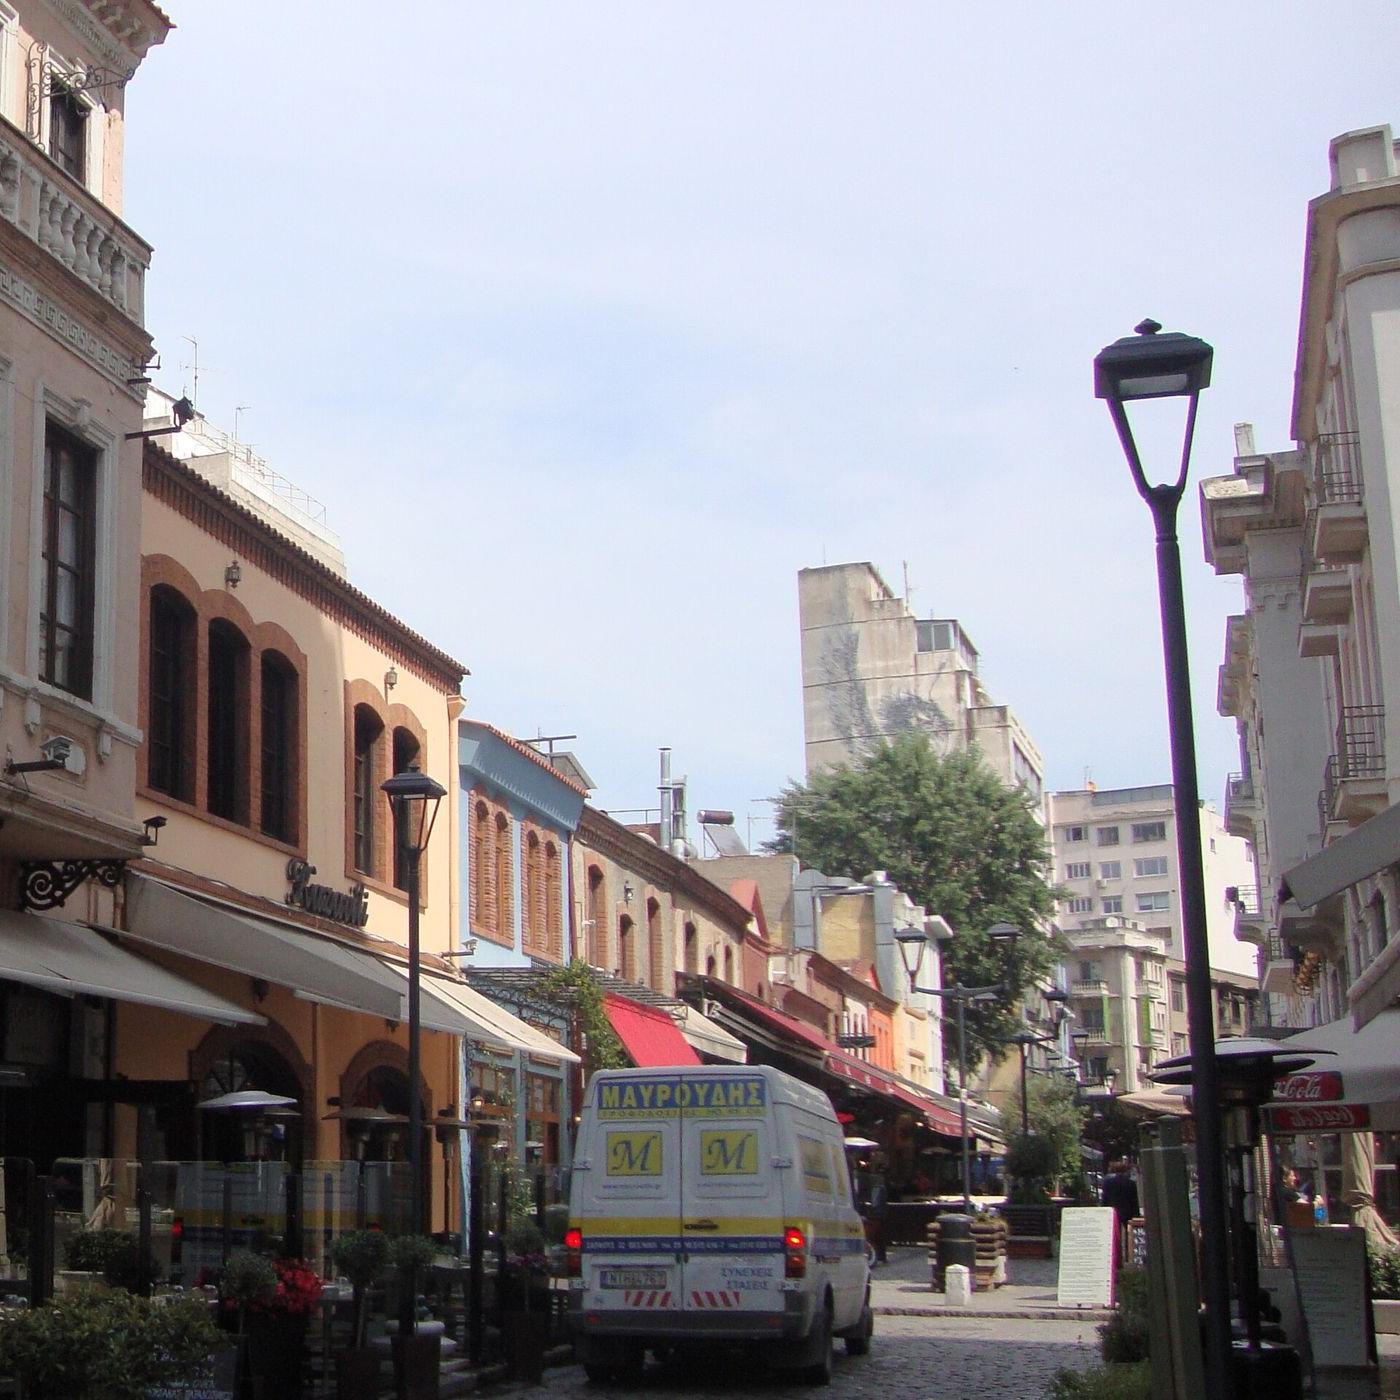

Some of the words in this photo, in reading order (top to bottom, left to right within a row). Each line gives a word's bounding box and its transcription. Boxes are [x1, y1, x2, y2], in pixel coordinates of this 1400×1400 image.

[602, 1081, 761, 1108] ΜΑΥΡΟΥΔΗΣ
[720, 1267, 773, 1278] ΣΥΝΕΧΕΙΣ
[725, 1280, 768, 1290] ΣΤΑΣΕΙΣ
